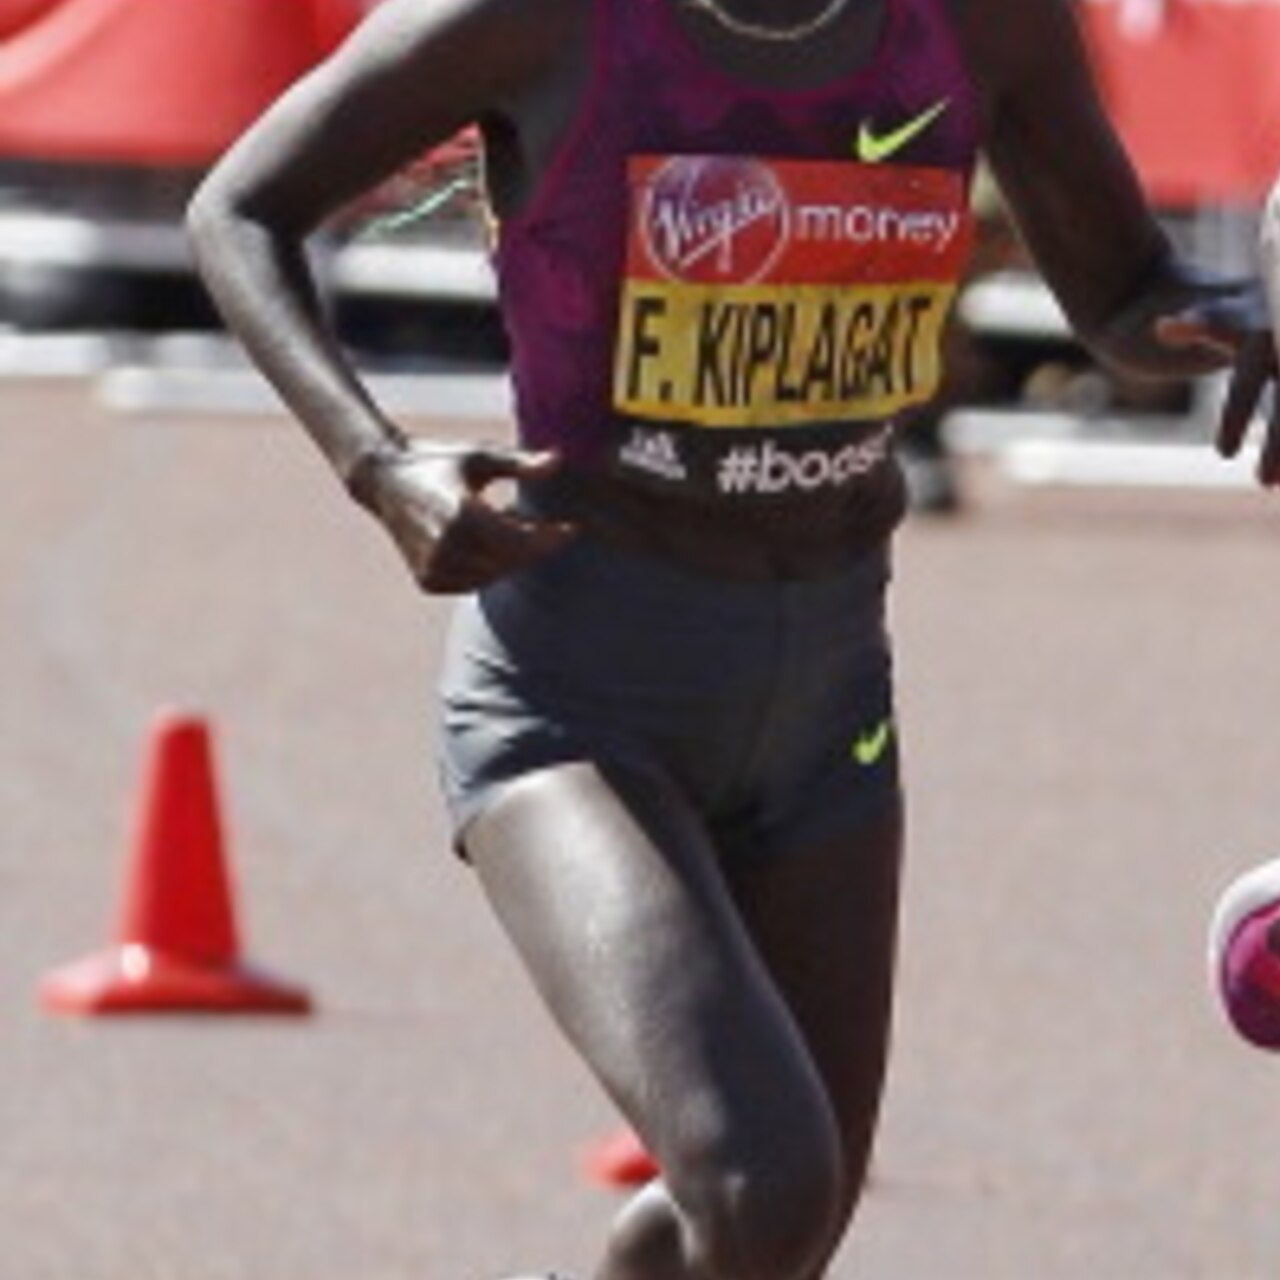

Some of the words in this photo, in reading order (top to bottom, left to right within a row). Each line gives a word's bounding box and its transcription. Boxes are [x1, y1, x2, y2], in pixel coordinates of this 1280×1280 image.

[654, 160, 782, 272] Virgin
[797, 202, 958, 254] money
[626, 296, 673, 403] F.
[692, 294, 932, 408] KIPLAGAT
